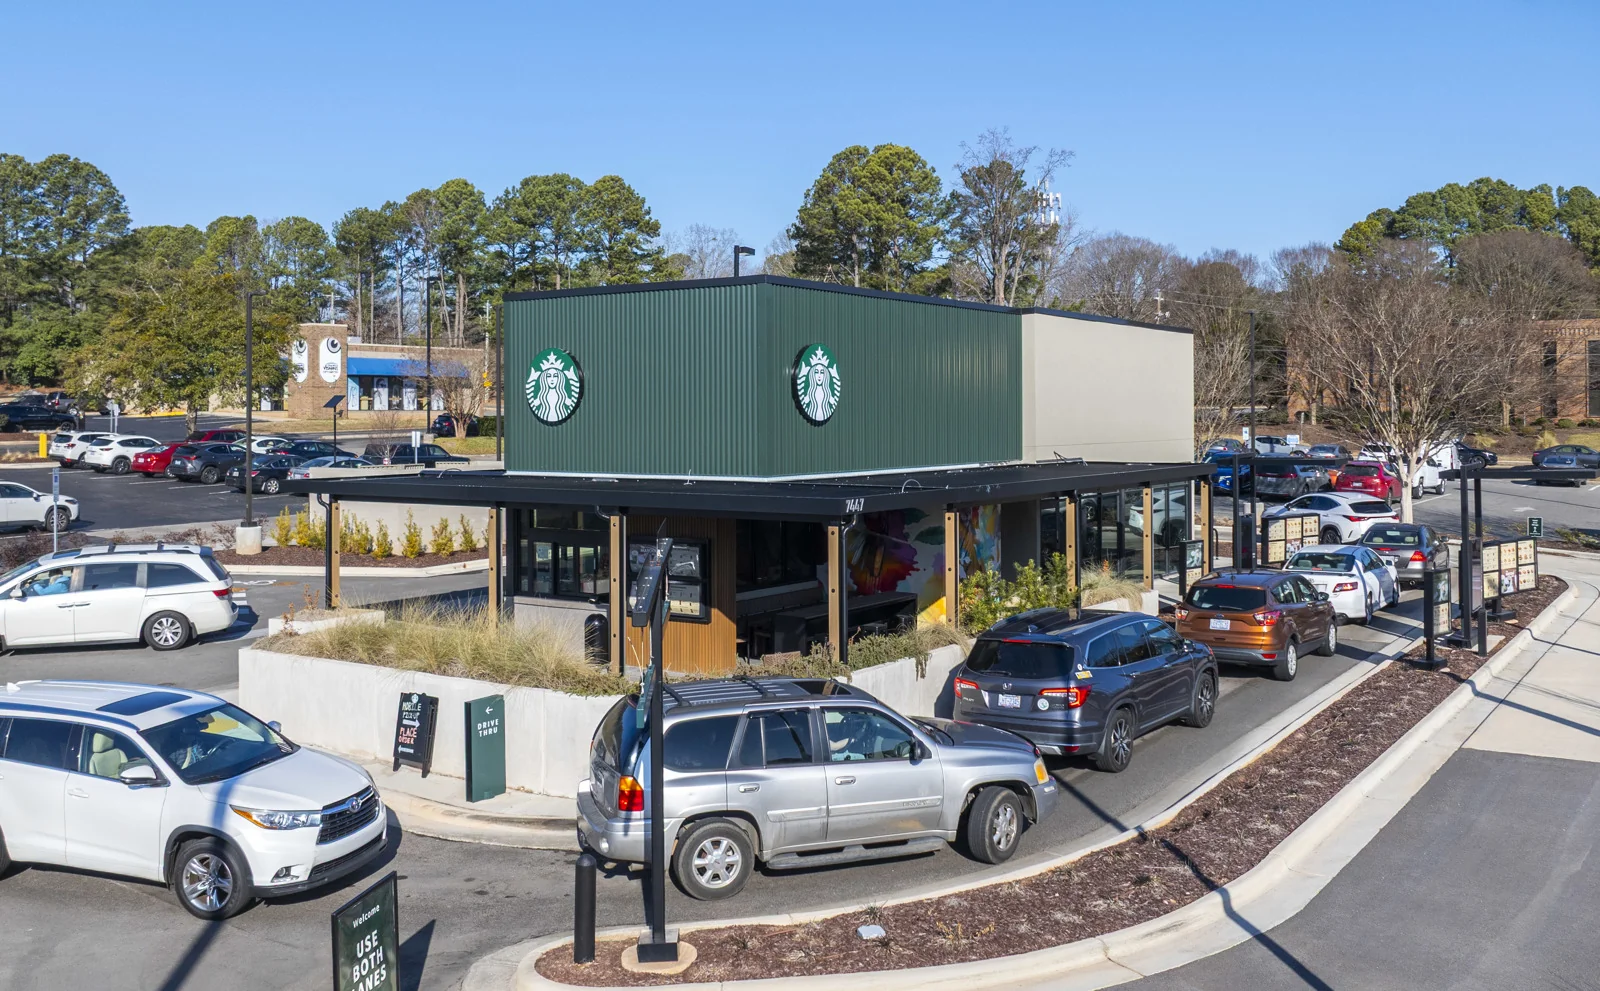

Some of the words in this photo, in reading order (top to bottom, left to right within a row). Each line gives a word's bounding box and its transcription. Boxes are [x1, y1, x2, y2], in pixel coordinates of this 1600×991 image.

[846, 498, 864, 513] 7447
[478, 719, 499, 730] DRIVE
[479, 727, 498, 737] THRU
[398, 736, 414, 744] ORDER
[400, 727, 417, 738] PLACE
[353, 905, 380, 928] Welcome
[356, 930, 378, 958] USE
[353, 946, 383, 983] BOTH
[352, 964, 387, 991] ANES
